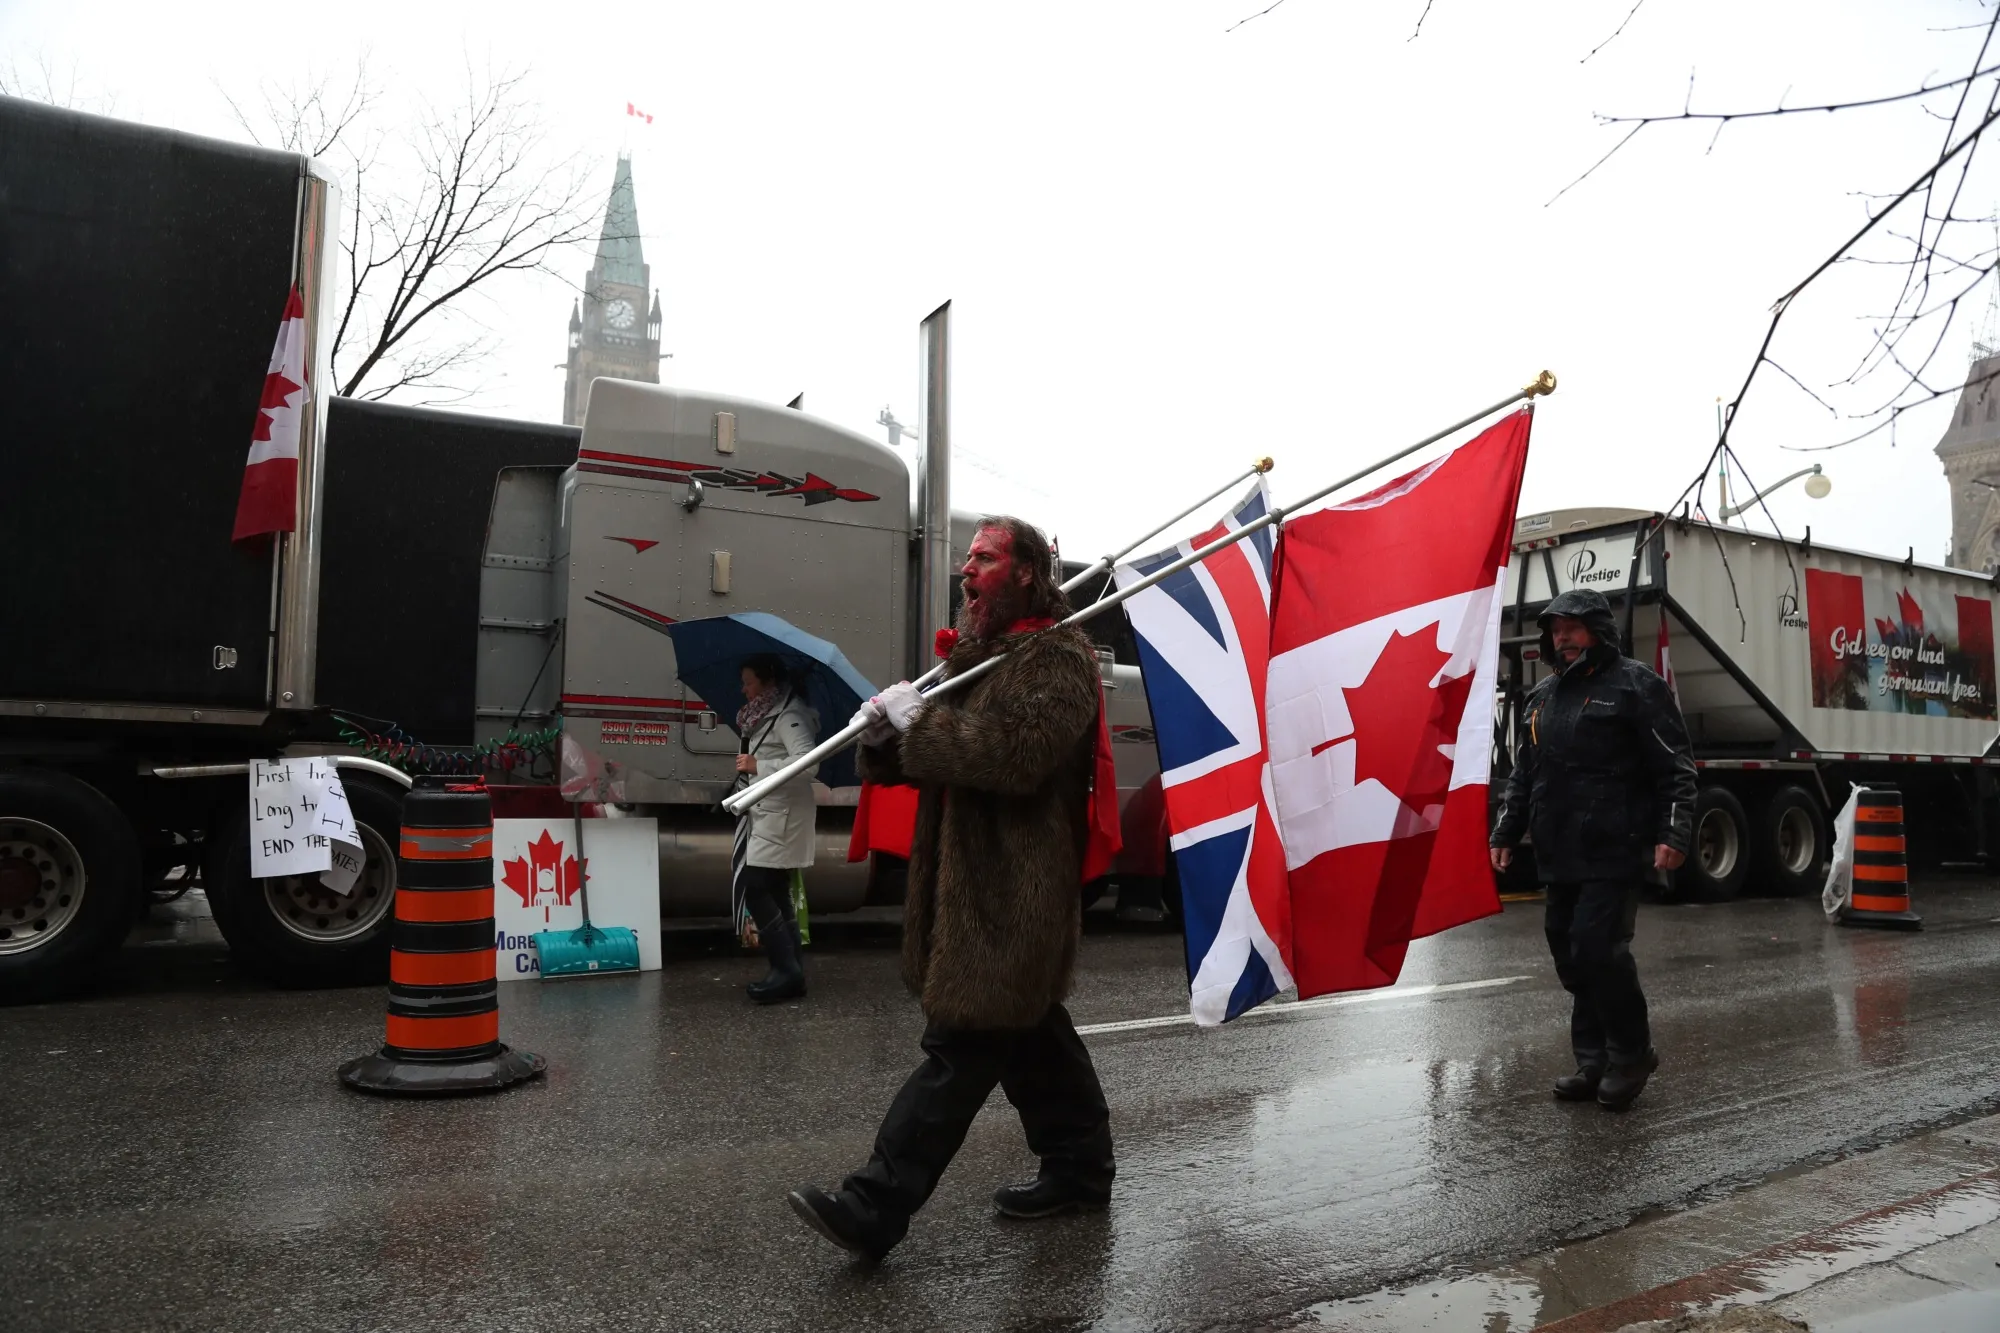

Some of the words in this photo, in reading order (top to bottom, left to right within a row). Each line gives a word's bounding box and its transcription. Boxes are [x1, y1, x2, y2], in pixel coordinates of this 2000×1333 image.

[1567, 542, 1621, 589] Prestige
[1777, 585, 1808, 631] Prestge
[601, 721, 632, 733] USDOT
[256, 763, 295, 787] First
[254, 797, 294, 829] Long
[262, 838, 295, 857] END
[302, 834, 330, 849] THE
